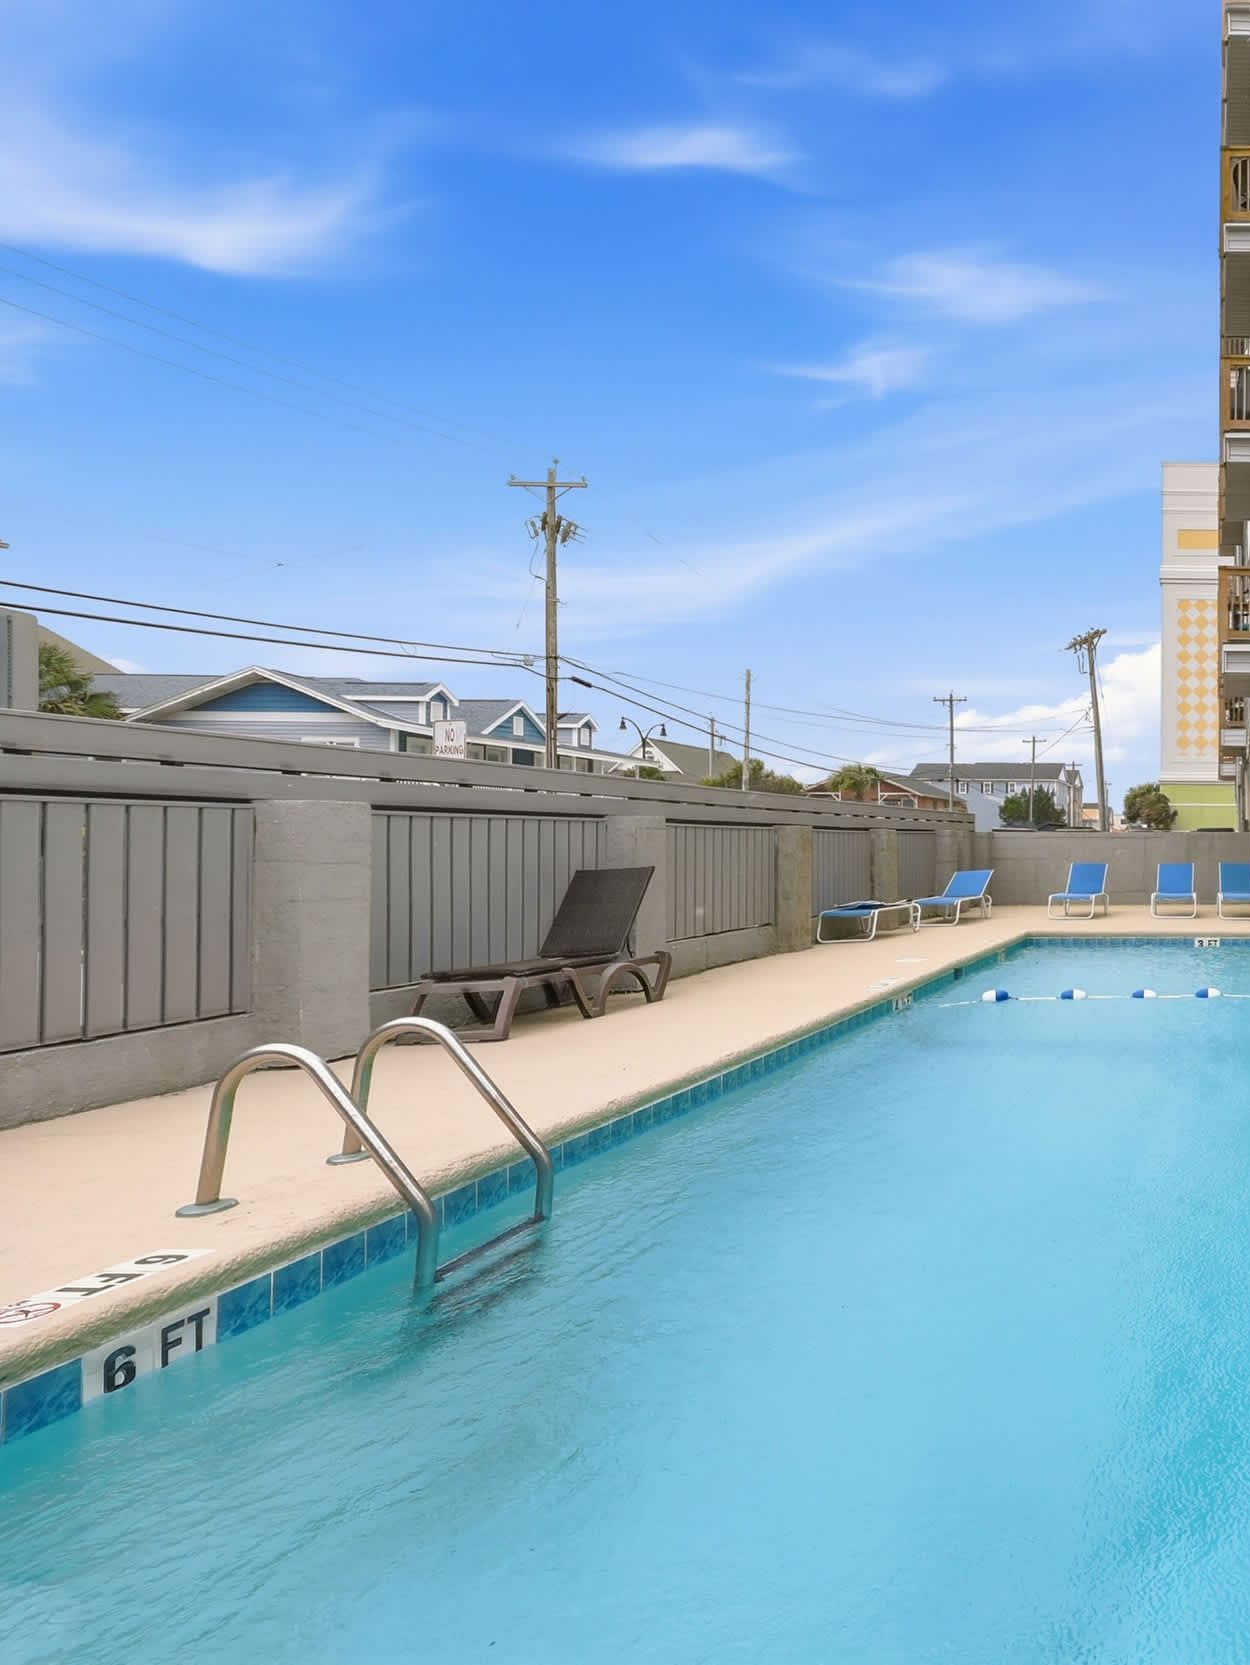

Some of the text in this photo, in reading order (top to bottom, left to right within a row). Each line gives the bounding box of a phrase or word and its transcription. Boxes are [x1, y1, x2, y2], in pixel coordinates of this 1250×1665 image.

[445, 727, 456, 742] NO
[435, 744, 464, 756] PARKING
[56, 1254, 189, 1297] 6 FT
[103, 1307, 210, 1394] 6 FT
